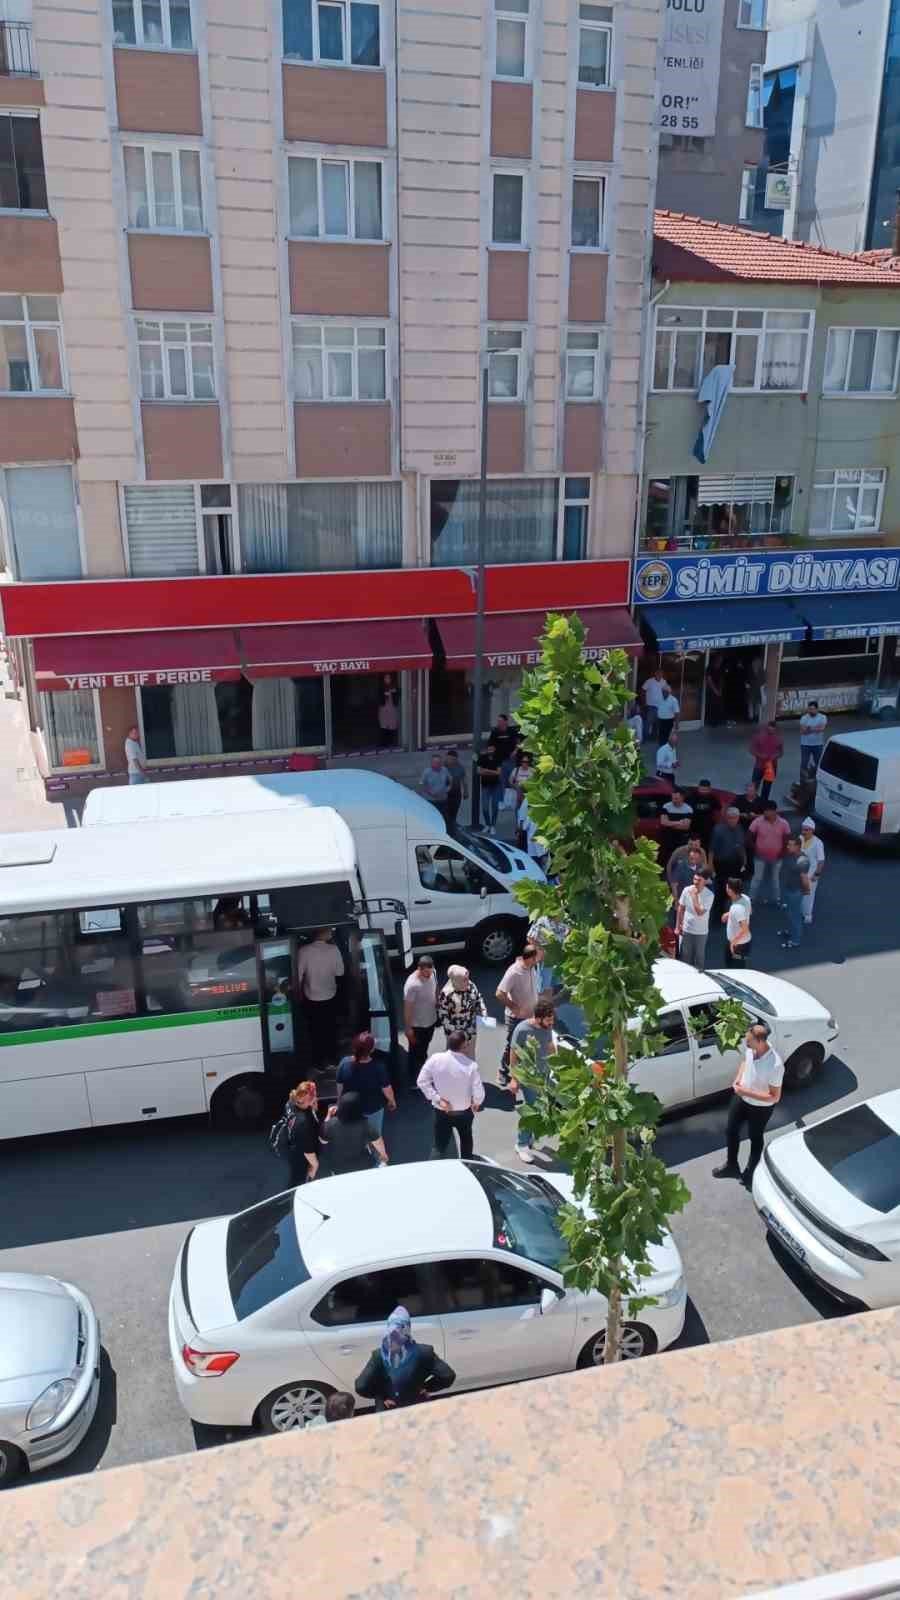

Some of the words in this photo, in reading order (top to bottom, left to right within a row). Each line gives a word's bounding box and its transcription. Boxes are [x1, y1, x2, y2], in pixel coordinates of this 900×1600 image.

[660, 114, 678, 128] 28
[681, 116, 699, 129] 55
[674, 557, 766, 600] SİMİT
[767, 553, 899, 593] DÜNYASI
[65, 675, 107, 690] YENİ
[112, 672, 149, 687] ELİF
[155, 668, 212, 685] PERDE
